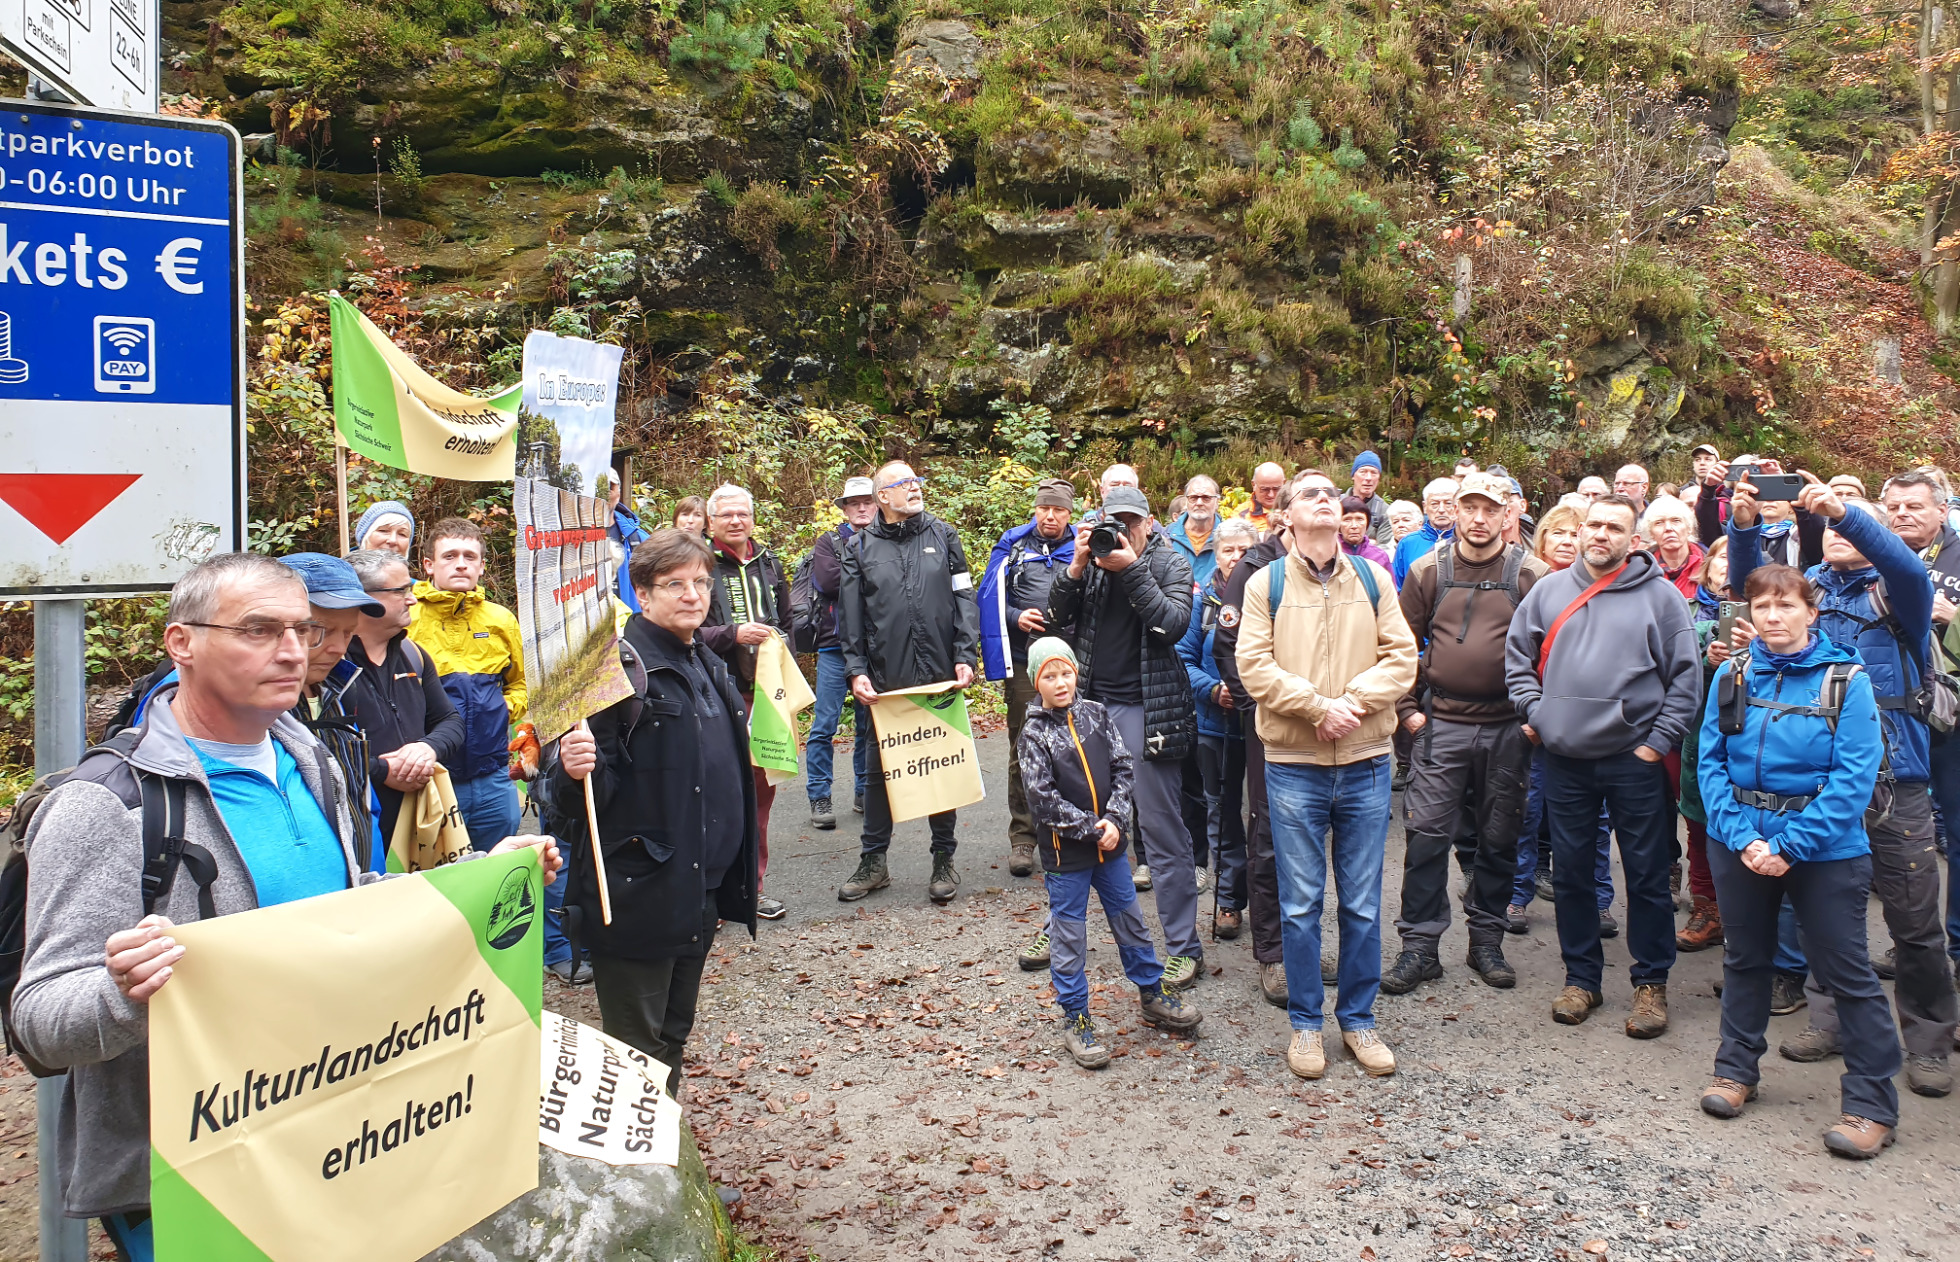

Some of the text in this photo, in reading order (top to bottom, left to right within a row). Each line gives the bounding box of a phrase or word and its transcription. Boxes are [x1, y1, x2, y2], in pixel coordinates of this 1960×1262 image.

[42, 13, 54, 30] mit
[27, 16, 68, 60] Parkschein
[116, 31, 141, 73] 22-6h
[127, 177, 187, 205] Uhr
[0, 223, 204, 295] kets €
[109, 362, 140, 375] PAY
[539, 373, 555, 400] In
[525, 525, 585, 551] Grenzwege
[881, 726, 947, 750] rbinden,
[907, 748, 965, 777] öffnen!
[189, 988, 486, 1143] Kulturlandschaft
[322, 1073, 474, 1180] erhalten!
